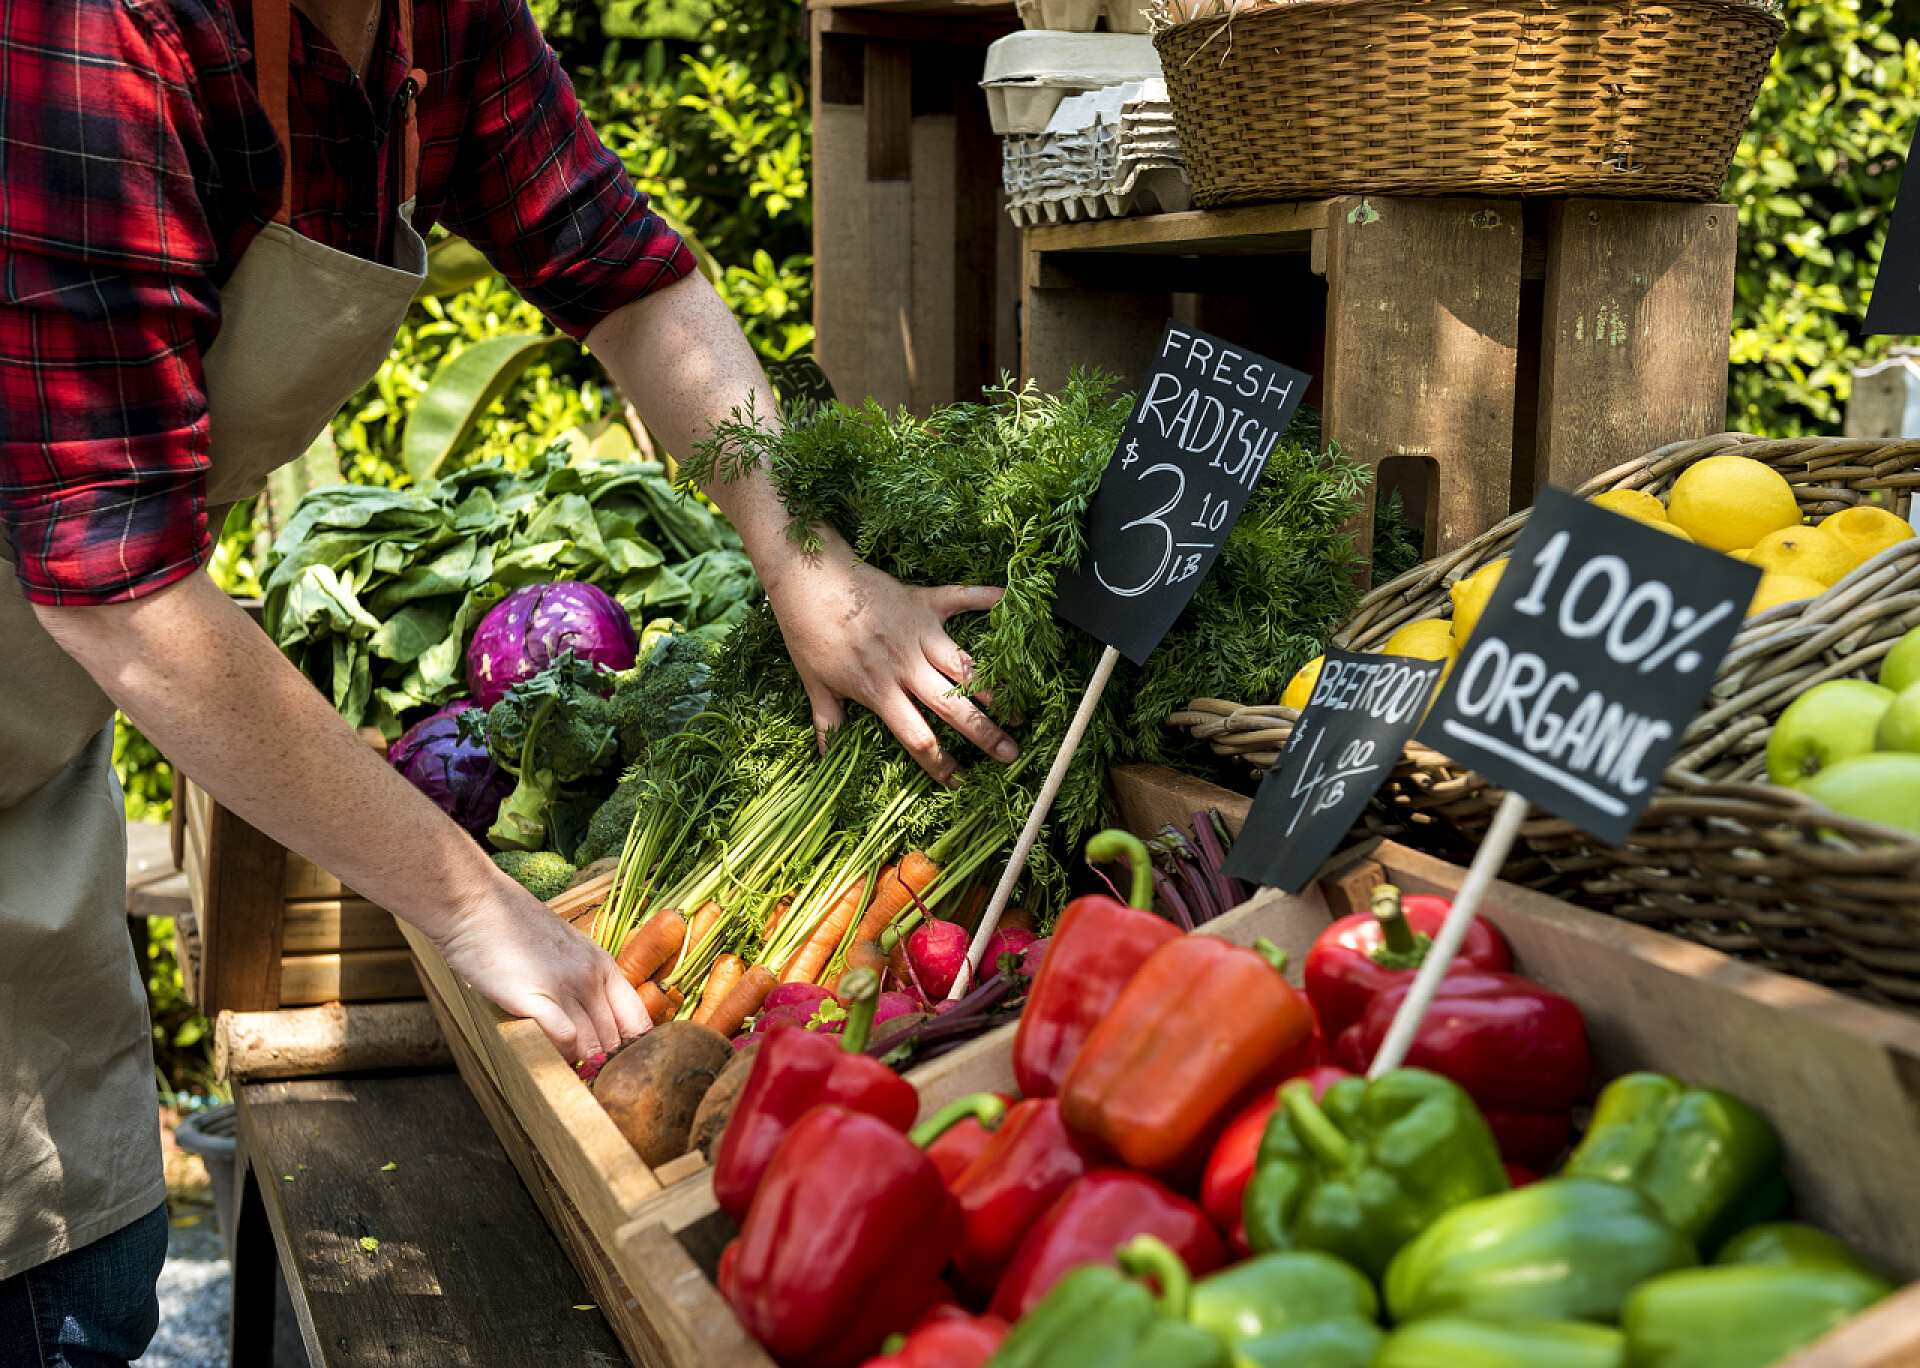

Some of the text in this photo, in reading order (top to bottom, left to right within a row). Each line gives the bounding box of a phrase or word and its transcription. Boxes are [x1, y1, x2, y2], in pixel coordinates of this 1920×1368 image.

[1162, 329, 1293, 410] FRESH
[1137, 373, 1278, 490] RADISH
[1165, 553, 1202, 585] LB
[1513, 530, 1735, 674] 100%
[1311, 659, 1440, 724] BEETROOT
[1455, 636, 1672, 795] ORGANIC
